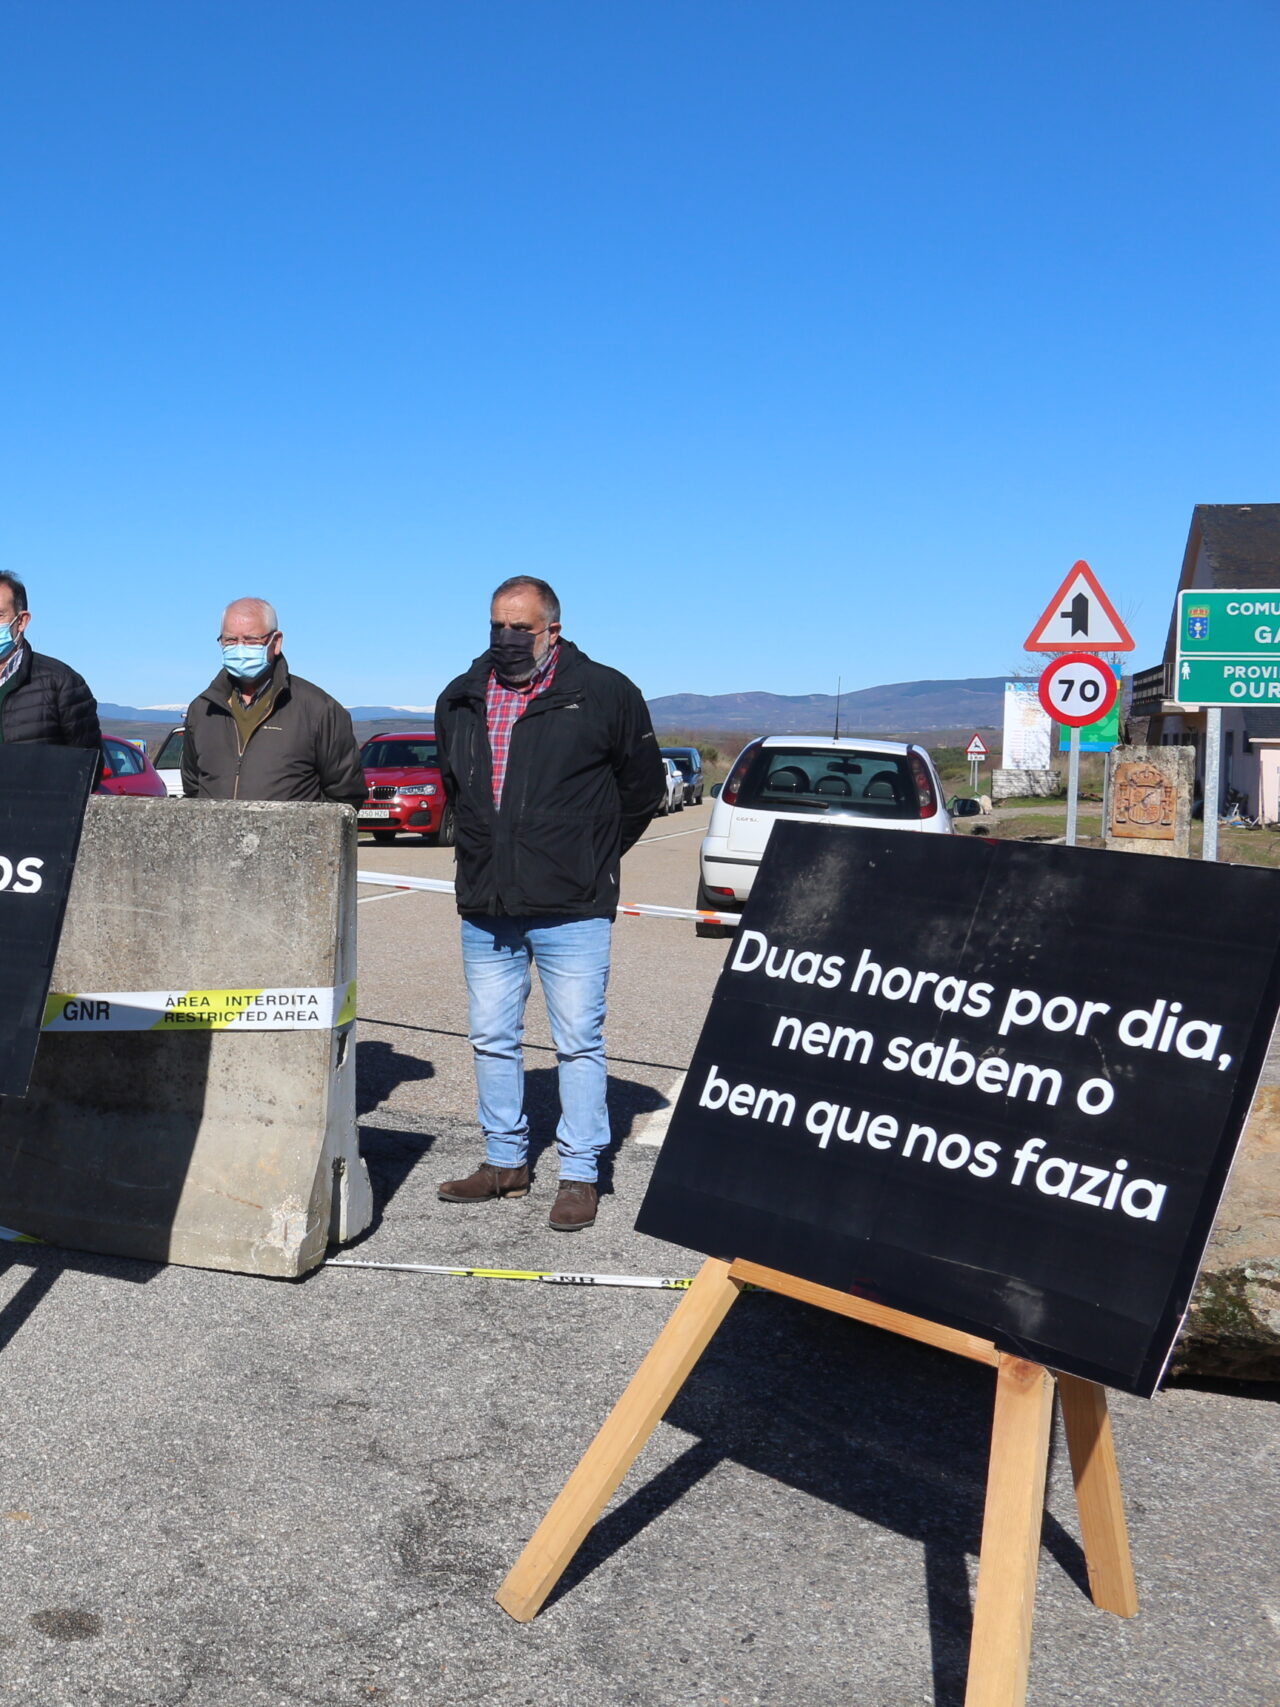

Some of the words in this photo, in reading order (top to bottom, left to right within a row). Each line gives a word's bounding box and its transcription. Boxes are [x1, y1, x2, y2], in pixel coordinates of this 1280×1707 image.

[1058, 679, 1100, 702] 70
[63, 1000, 110, 1022] GNR
[165, 994, 210, 1007] ÁREA
[225, 994, 318, 1007] INTERDITA
[730, 929, 846, 989] Duas
[850, 948, 995, 1018] horas
[998, 987, 1112, 1036] por
[1118, 999, 1233, 1071] dia,
[164, 1010, 267, 1023] RESTRICTED
[273, 1010, 319, 1022] AREA
[771, 1015, 874, 1064] nem
[883, 1035, 1063, 1106] sabem
[1077, 1078, 1115, 1115] o
[698, 1065, 796, 1127] bem
[805, 1100, 899, 1150] que
[902, 1123, 1000, 1179] nos
[1011, 1137, 1167, 1222] fazia
